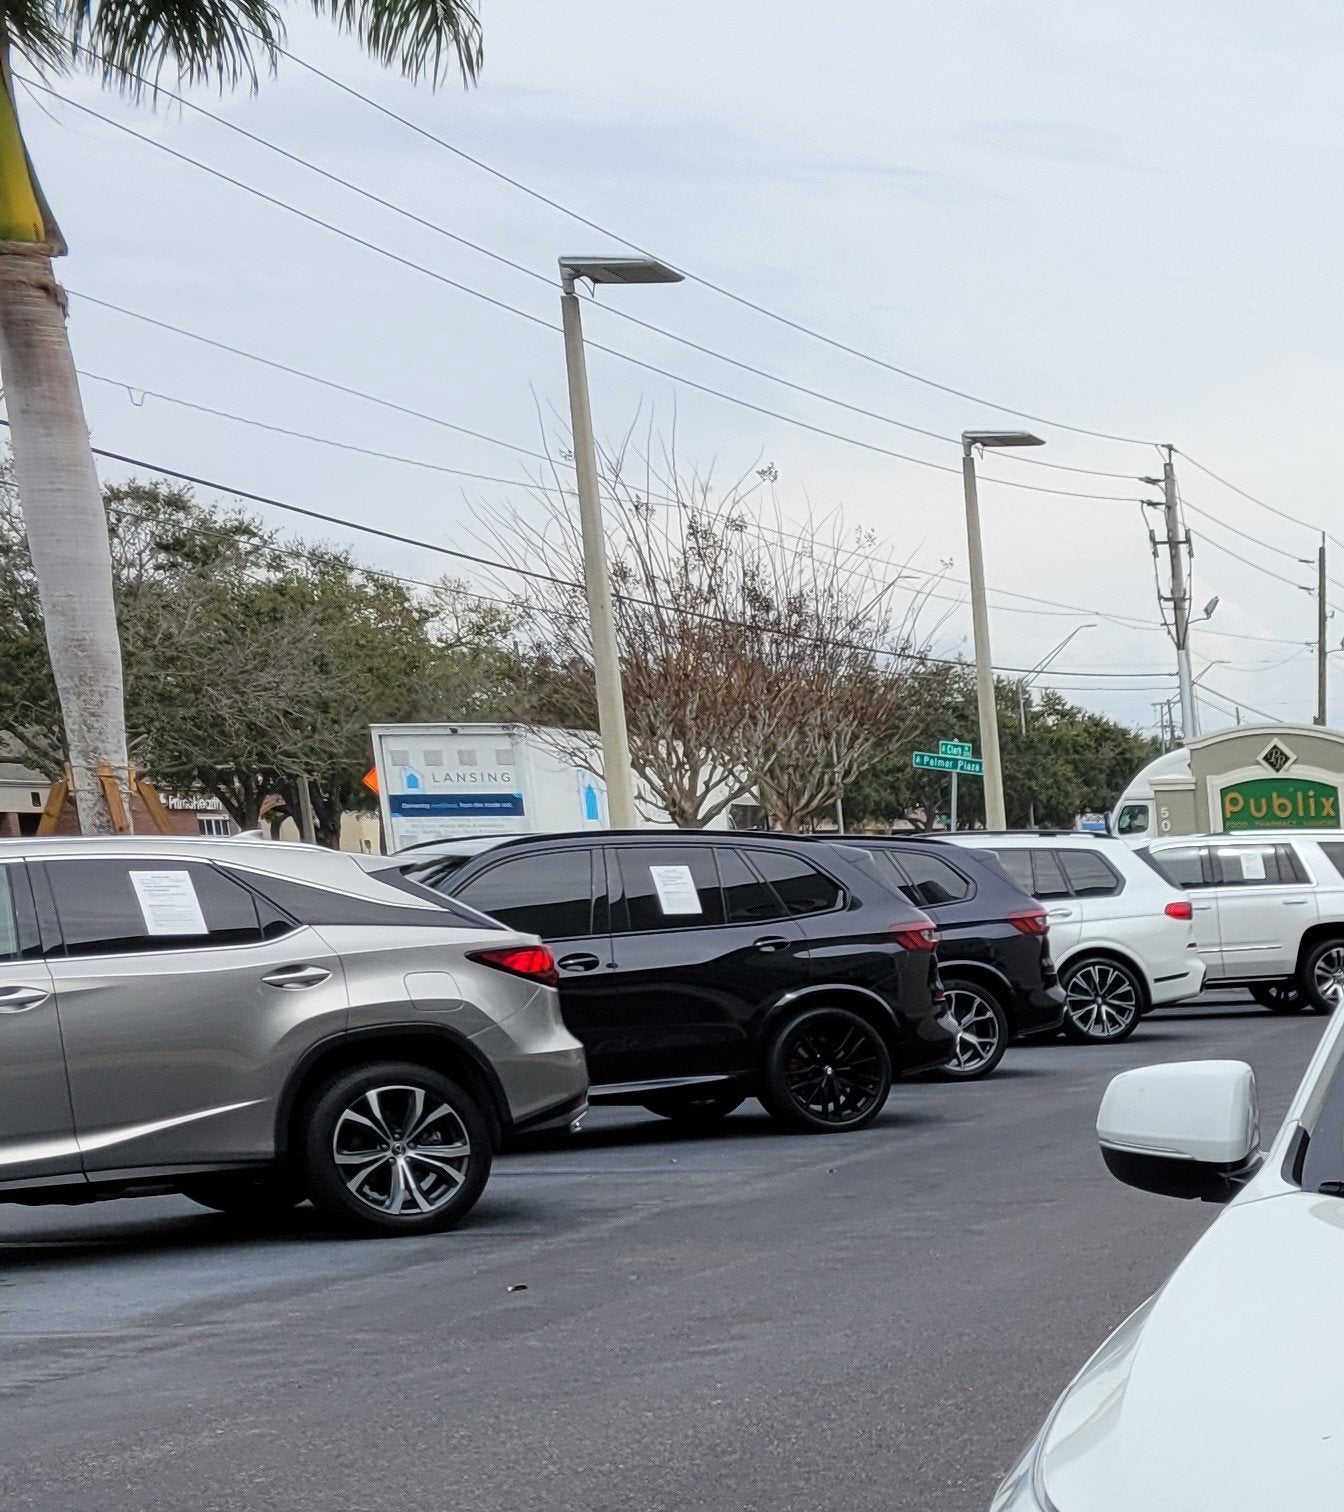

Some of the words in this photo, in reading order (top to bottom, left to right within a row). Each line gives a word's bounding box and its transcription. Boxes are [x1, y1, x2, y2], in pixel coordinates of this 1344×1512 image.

[923, 756, 953, 768] Palmer
[431, 772, 511, 783] LANSING
[1223, 789, 1336, 819] Publix
